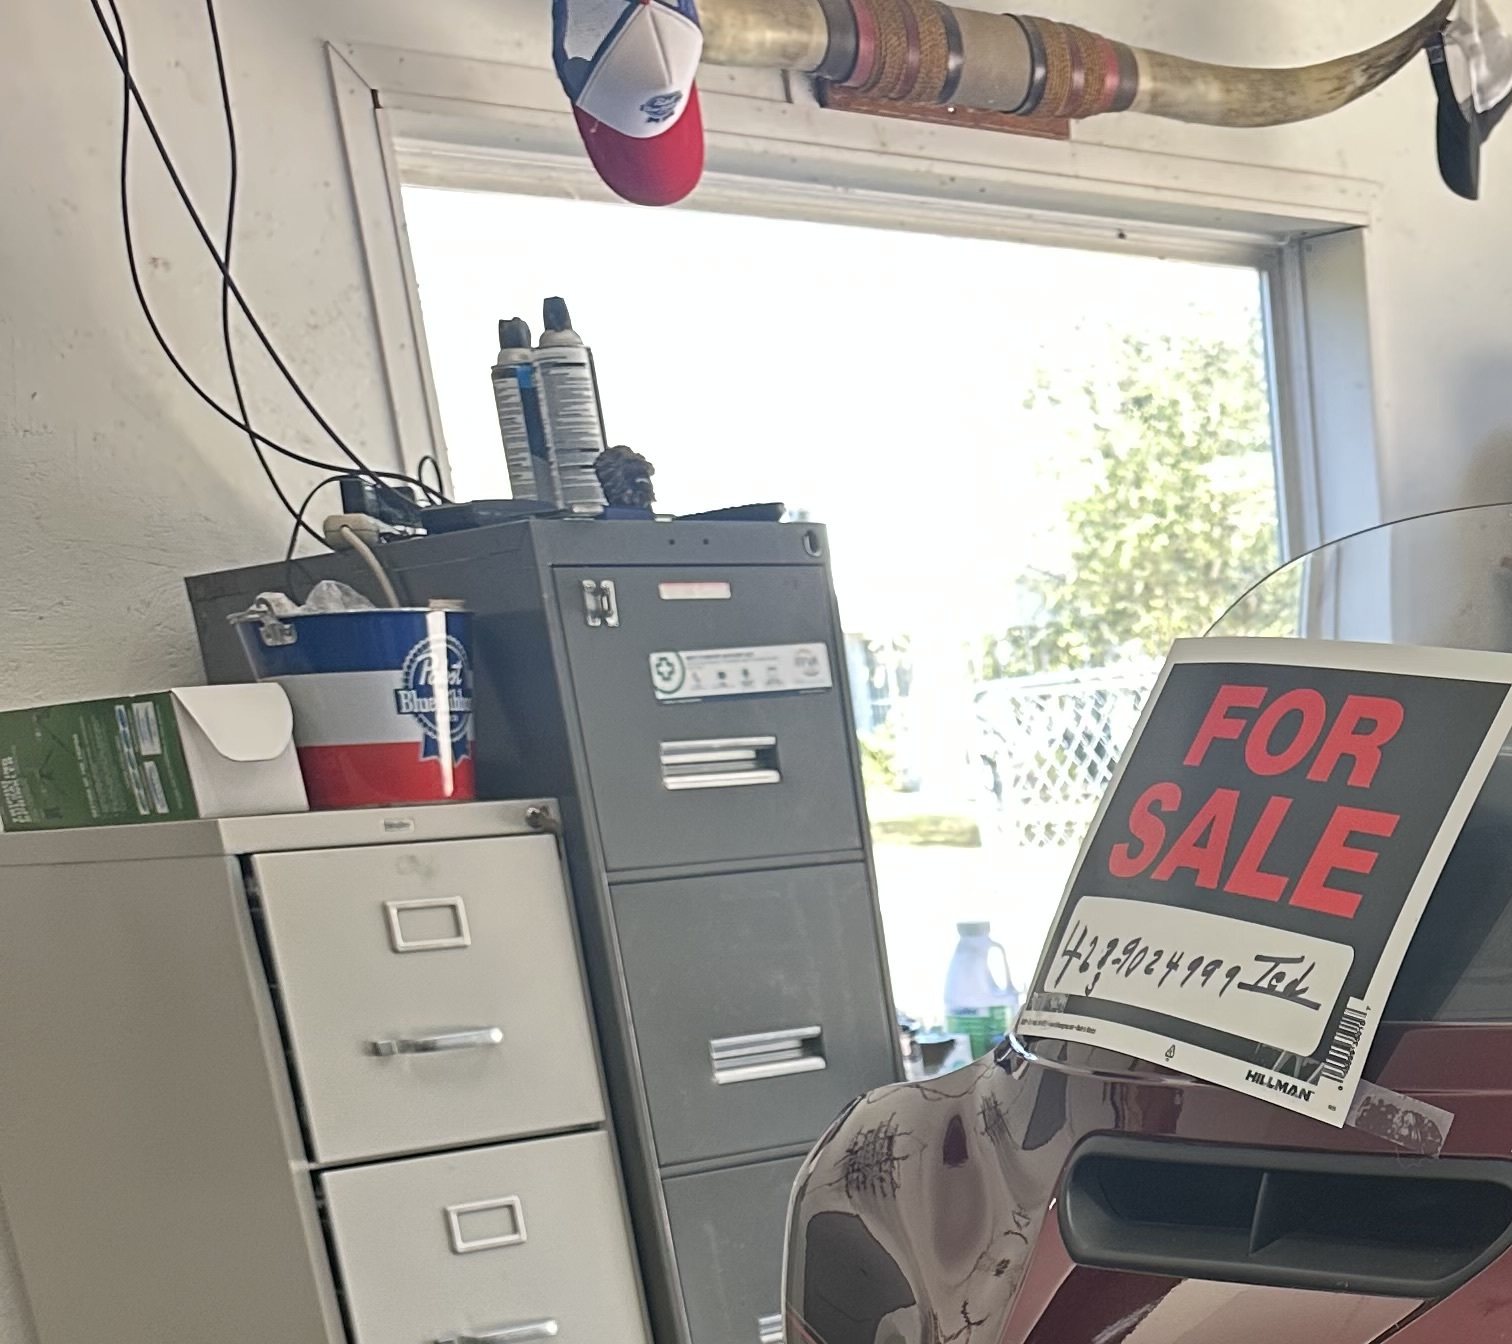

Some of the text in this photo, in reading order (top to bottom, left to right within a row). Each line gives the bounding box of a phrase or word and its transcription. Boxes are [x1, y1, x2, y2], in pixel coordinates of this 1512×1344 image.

[418, 659, 463, 686] Past
[1183, 684, 1405, 788] FOR
[1108, 782, 1400, 918] SALE
[1245, 1069, 1312, 1102] HILLMAN
